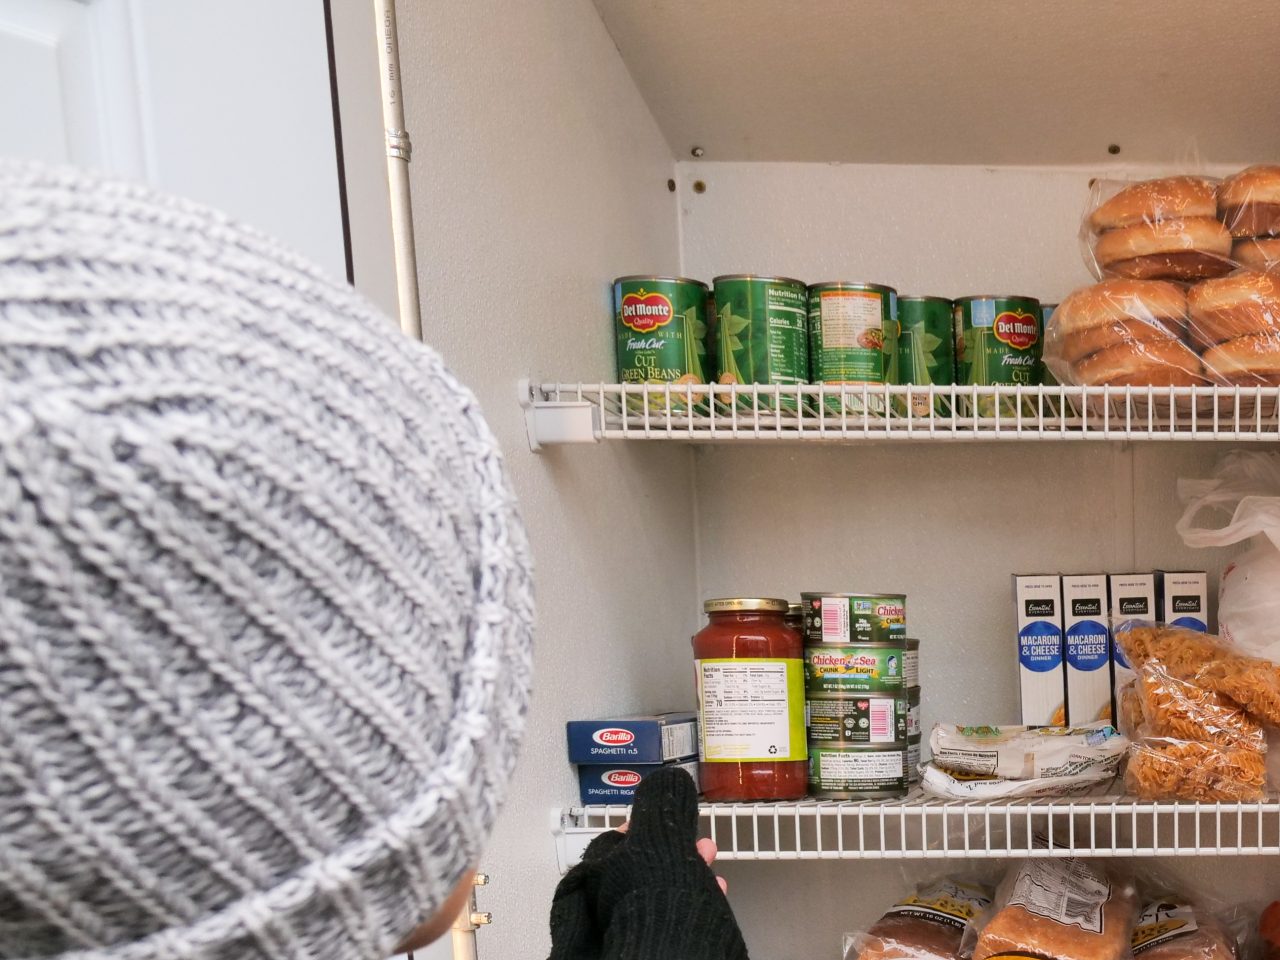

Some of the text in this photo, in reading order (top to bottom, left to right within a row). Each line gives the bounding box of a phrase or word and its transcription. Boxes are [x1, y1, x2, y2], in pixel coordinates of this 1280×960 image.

[768, 288, 797, 299] Nutrition
[623, 304, 669, 316] Del Monte
[769, 317, 790, 326] Calories
[998, 322, 1014, 333] Del
[627, 338, 646, 351] Fresh
[635, 355, 656, 367] CUT
[1001, 354, 1023, 366] Fresh
[621, 367, 681, 379] GREEN BEANS
[1012, 367, 1031, 381] CUT
[1028, 603, 1051, 611] Essential
[1075, 603, 1098, 611] Essential
[1122, 601, 1145, 609] Essential
[1020, 635, 1060, 645] MACARONI
[1067, 634, 1106, 645] MACARONI
[1022, 645, 1059, 656] & CHEESE
[1068, 644, 1106, 654] & CHEESE
[812, 655, 876, 666] Chicken Sea
[602, 732, 631, 741] Barilla
[610, 774, 638, 783] Barilla
